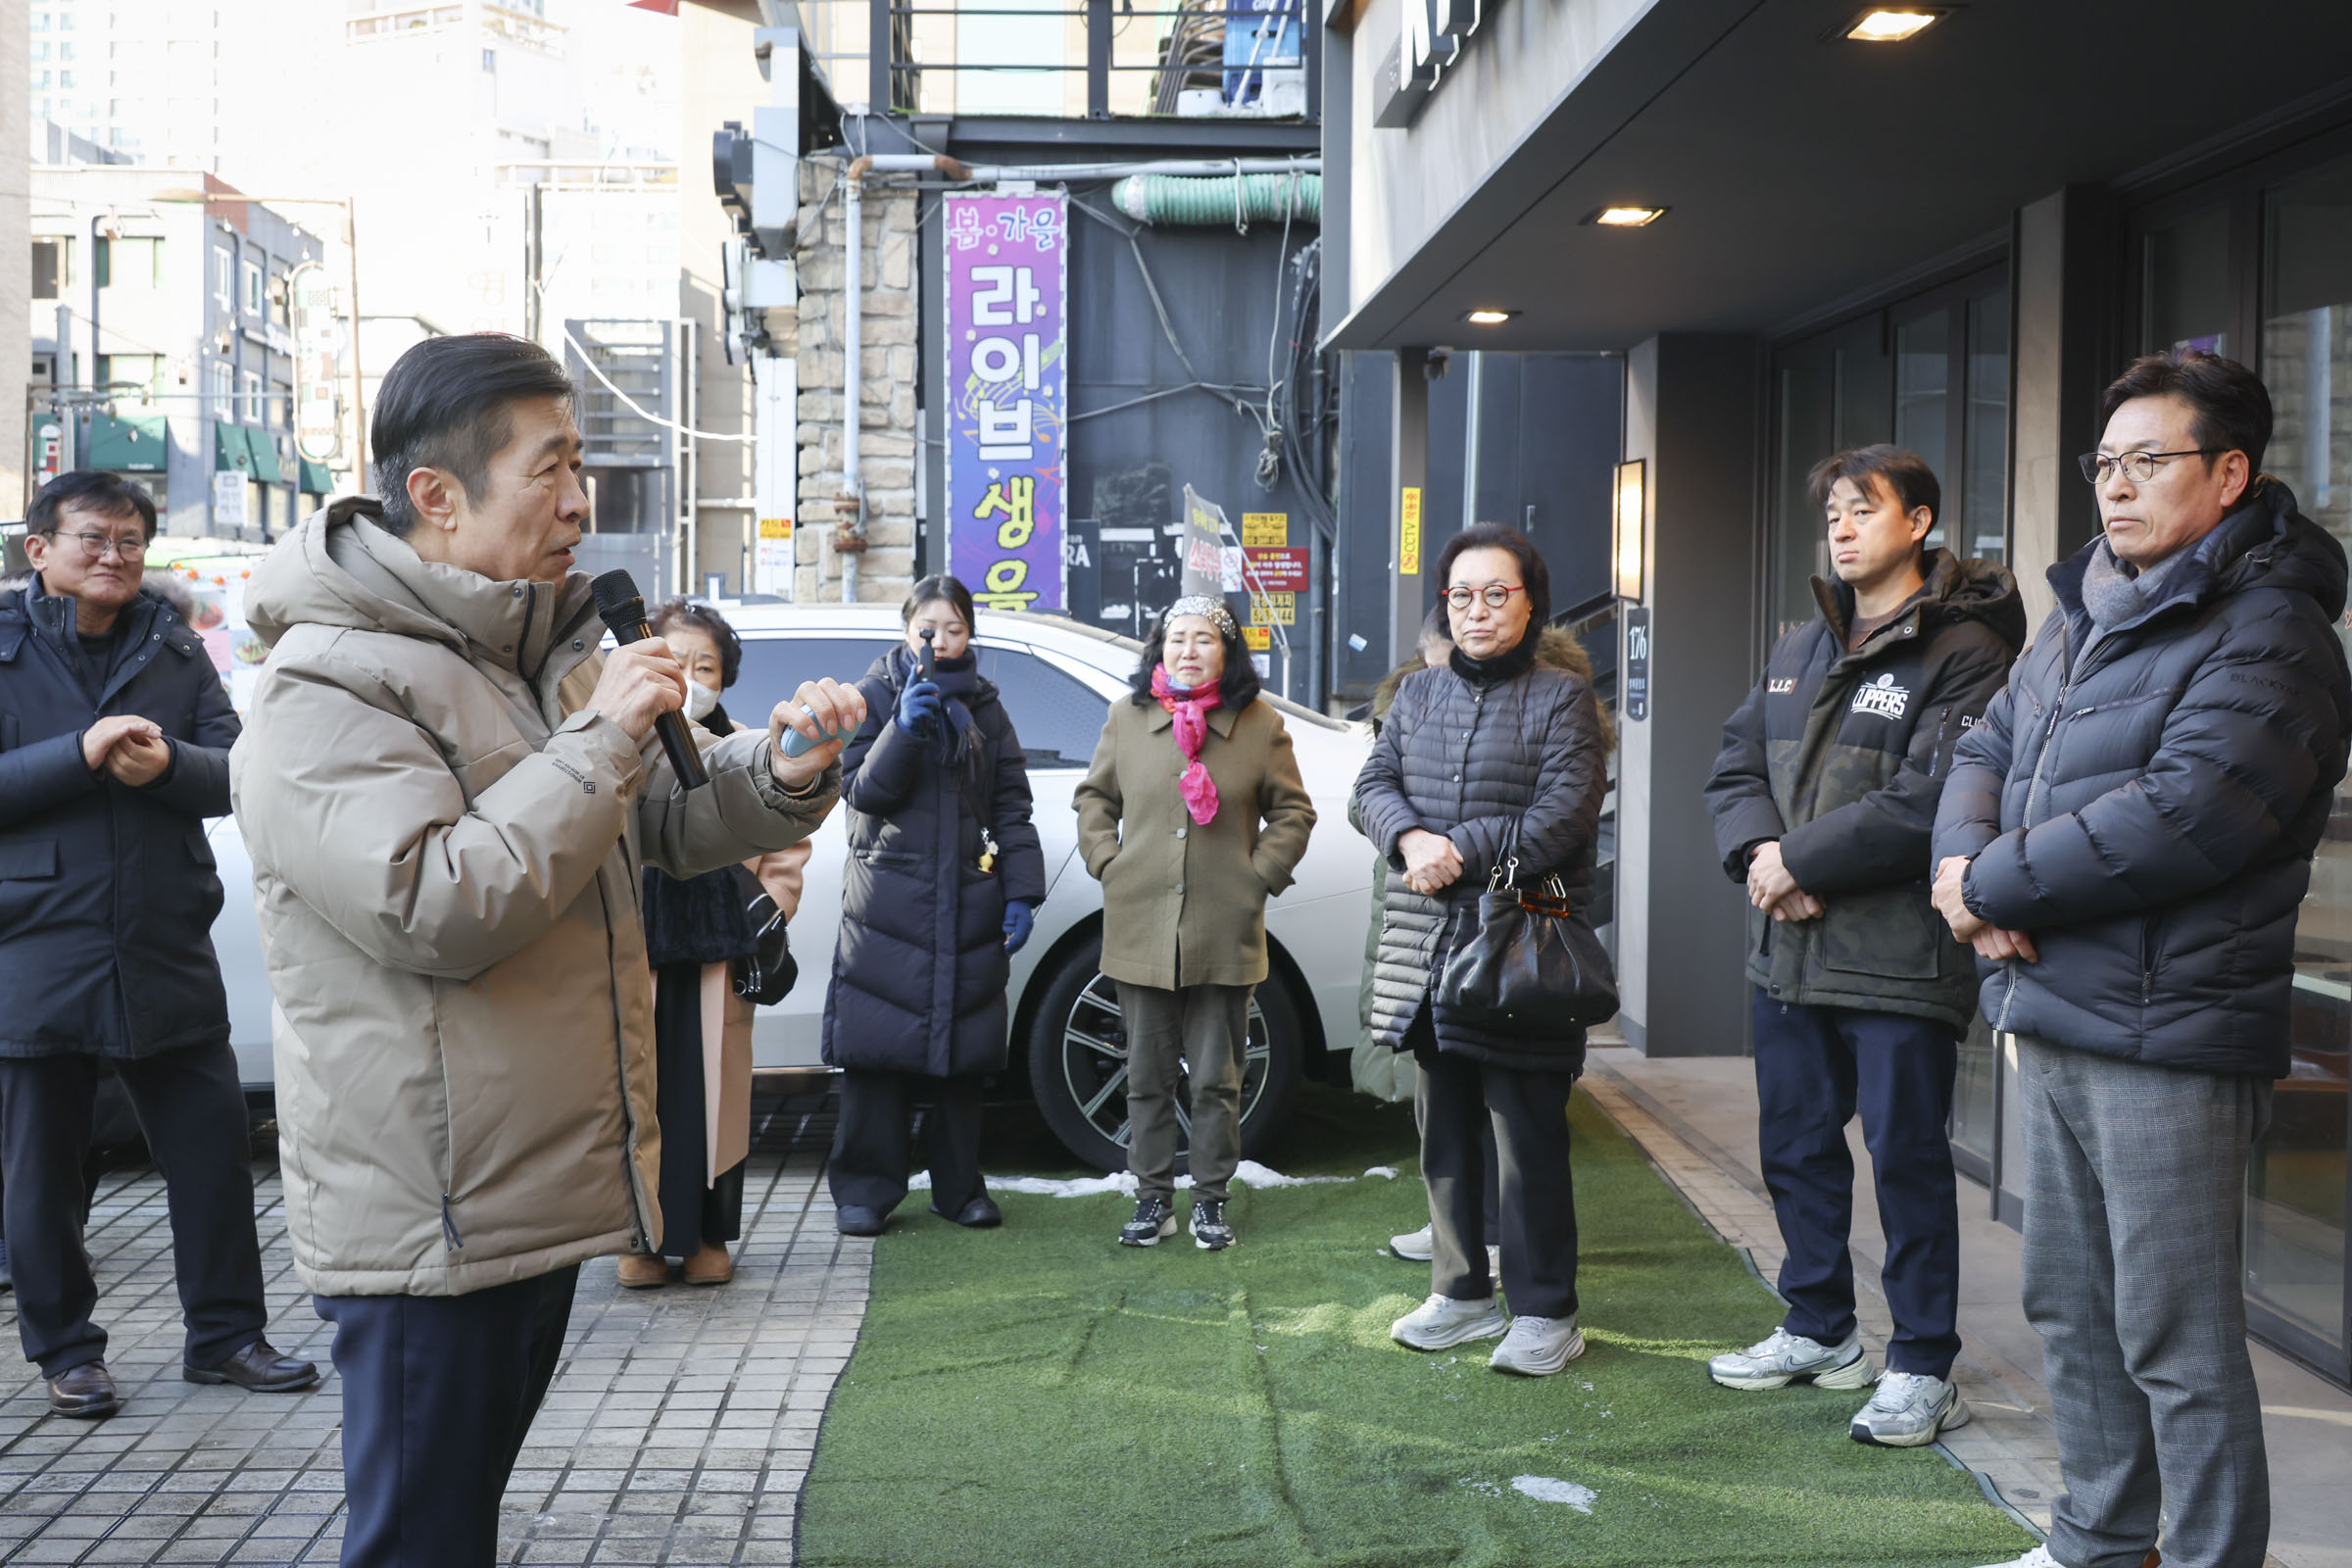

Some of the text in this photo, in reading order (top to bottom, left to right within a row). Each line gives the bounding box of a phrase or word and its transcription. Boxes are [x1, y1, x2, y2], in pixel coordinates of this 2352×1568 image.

[969, 265, 1043, 462] 라이브
[1403, 521, 1417, 553] CCTV
[1628, 624, 1647, 661] 176
[1851, 686, 1909, 716] CLIPPERS
